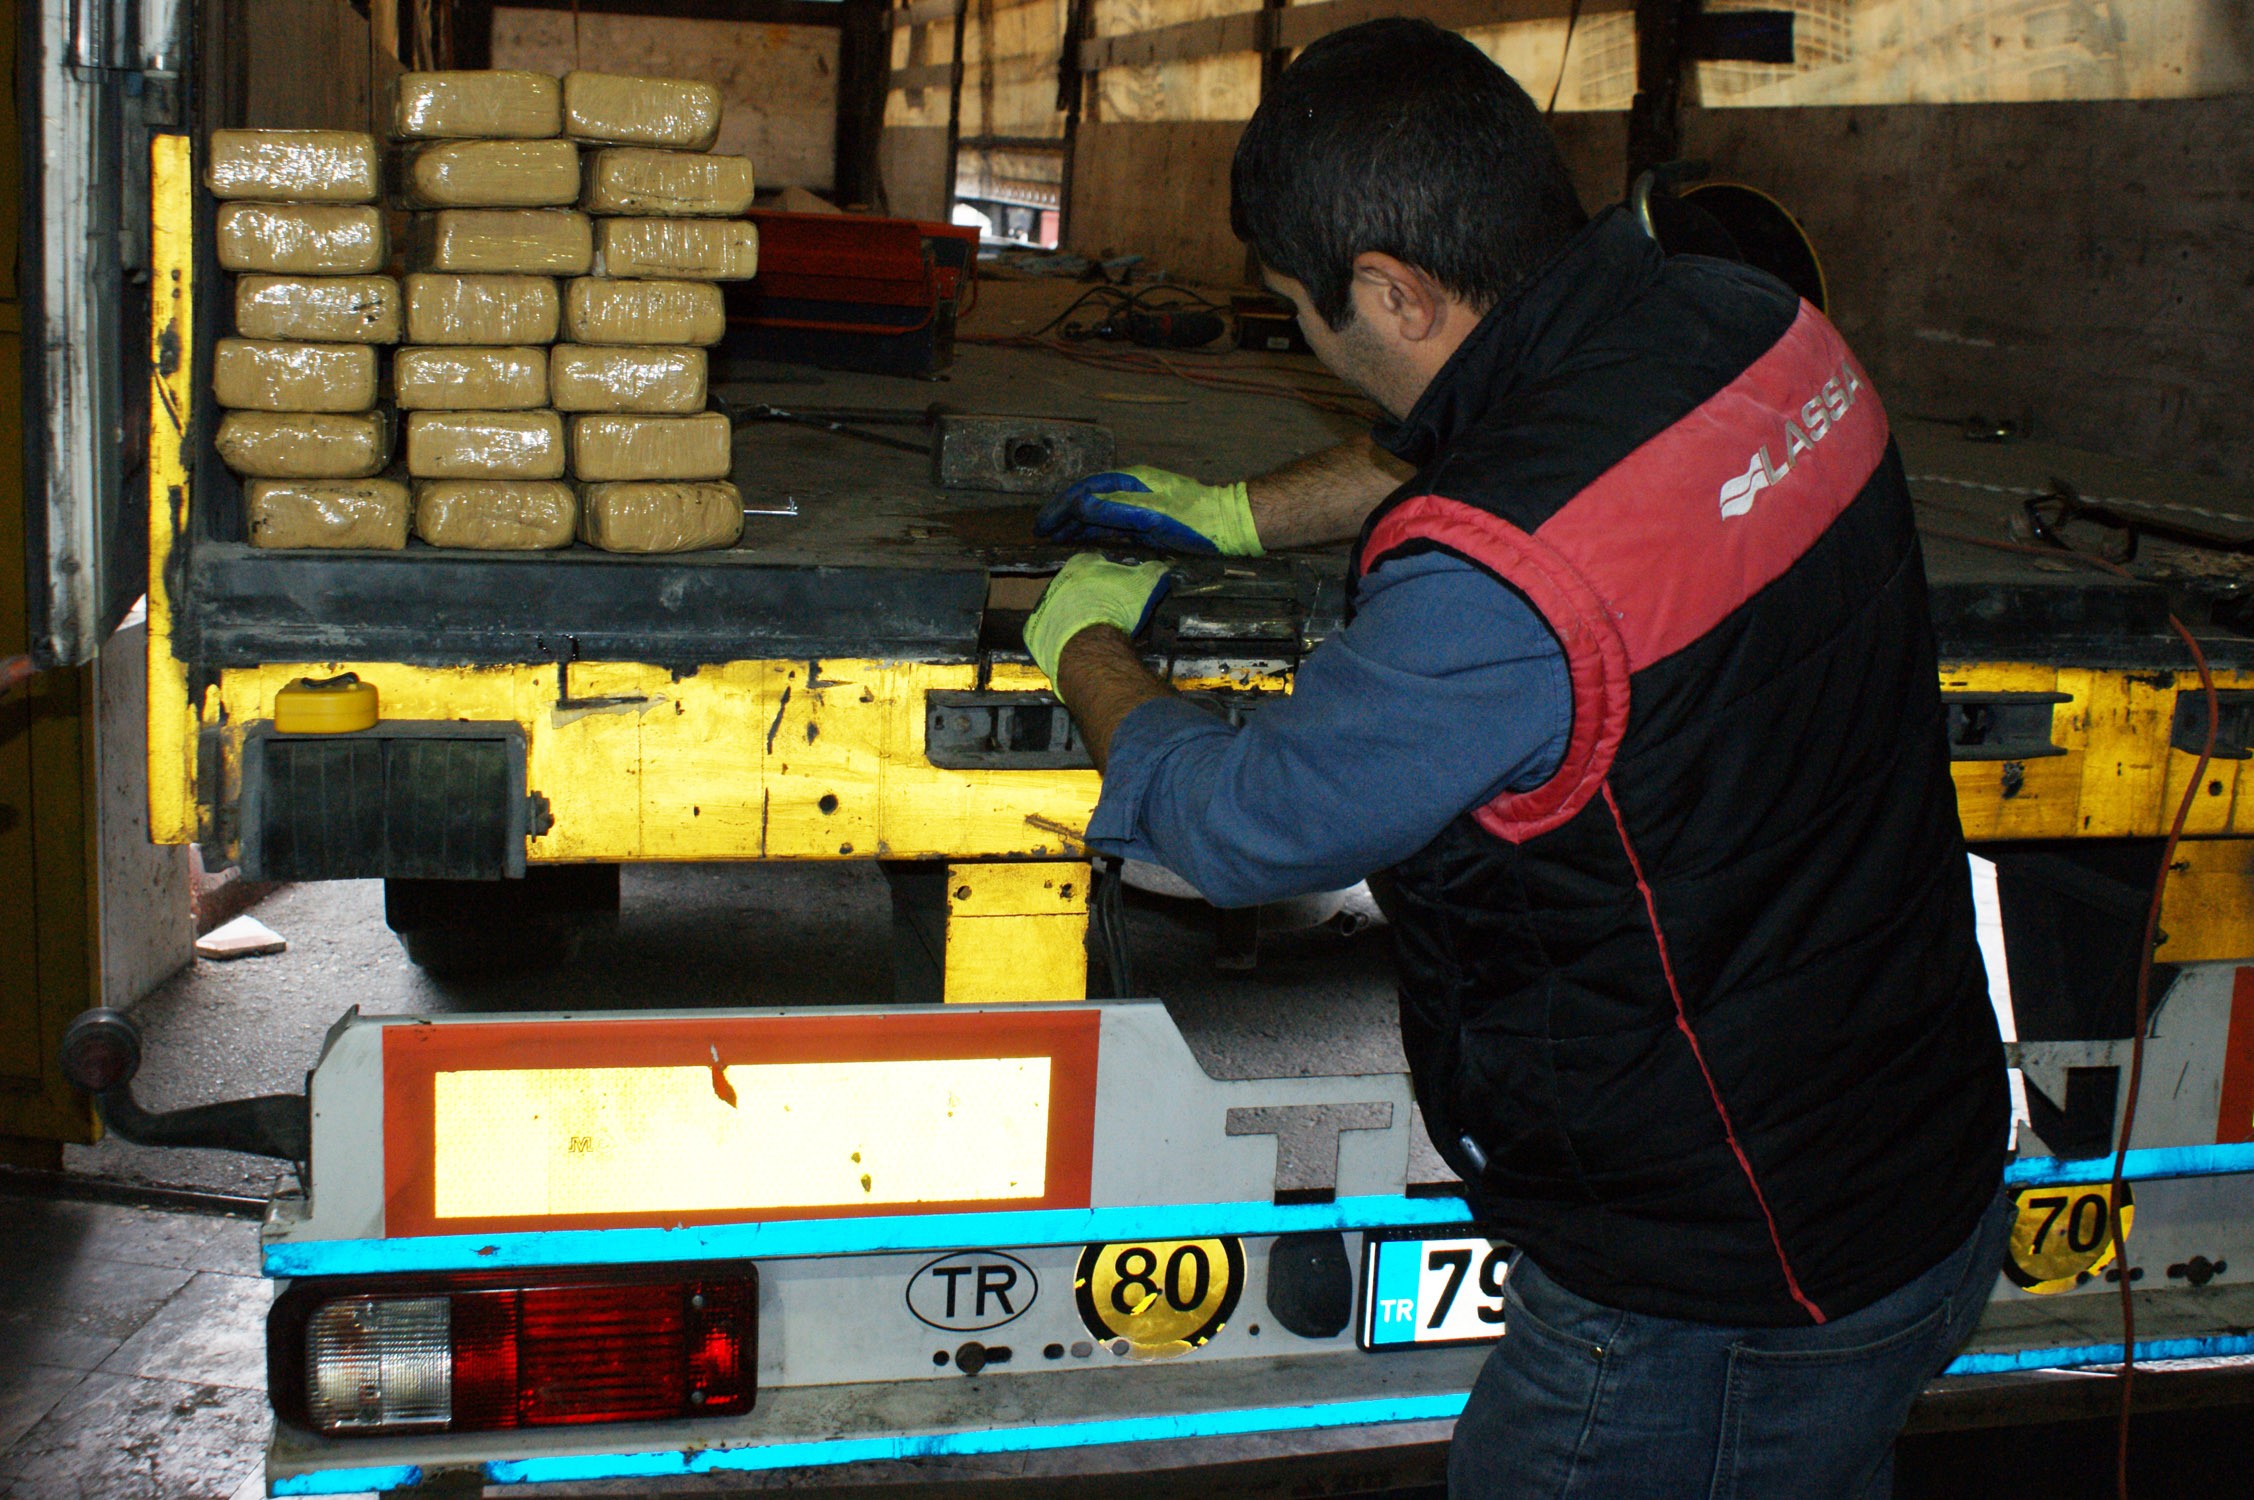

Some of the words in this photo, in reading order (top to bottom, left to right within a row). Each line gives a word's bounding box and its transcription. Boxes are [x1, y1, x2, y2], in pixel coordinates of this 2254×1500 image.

[1760, 361, 1865, 486] LASSA
[2028, 1194, 2109, 1255] 70
[932, 1264, 1017, 1318] TR
[1111, 1245, 1210, 1314] 80
[1380, 1299, 1414, 1323] TR
